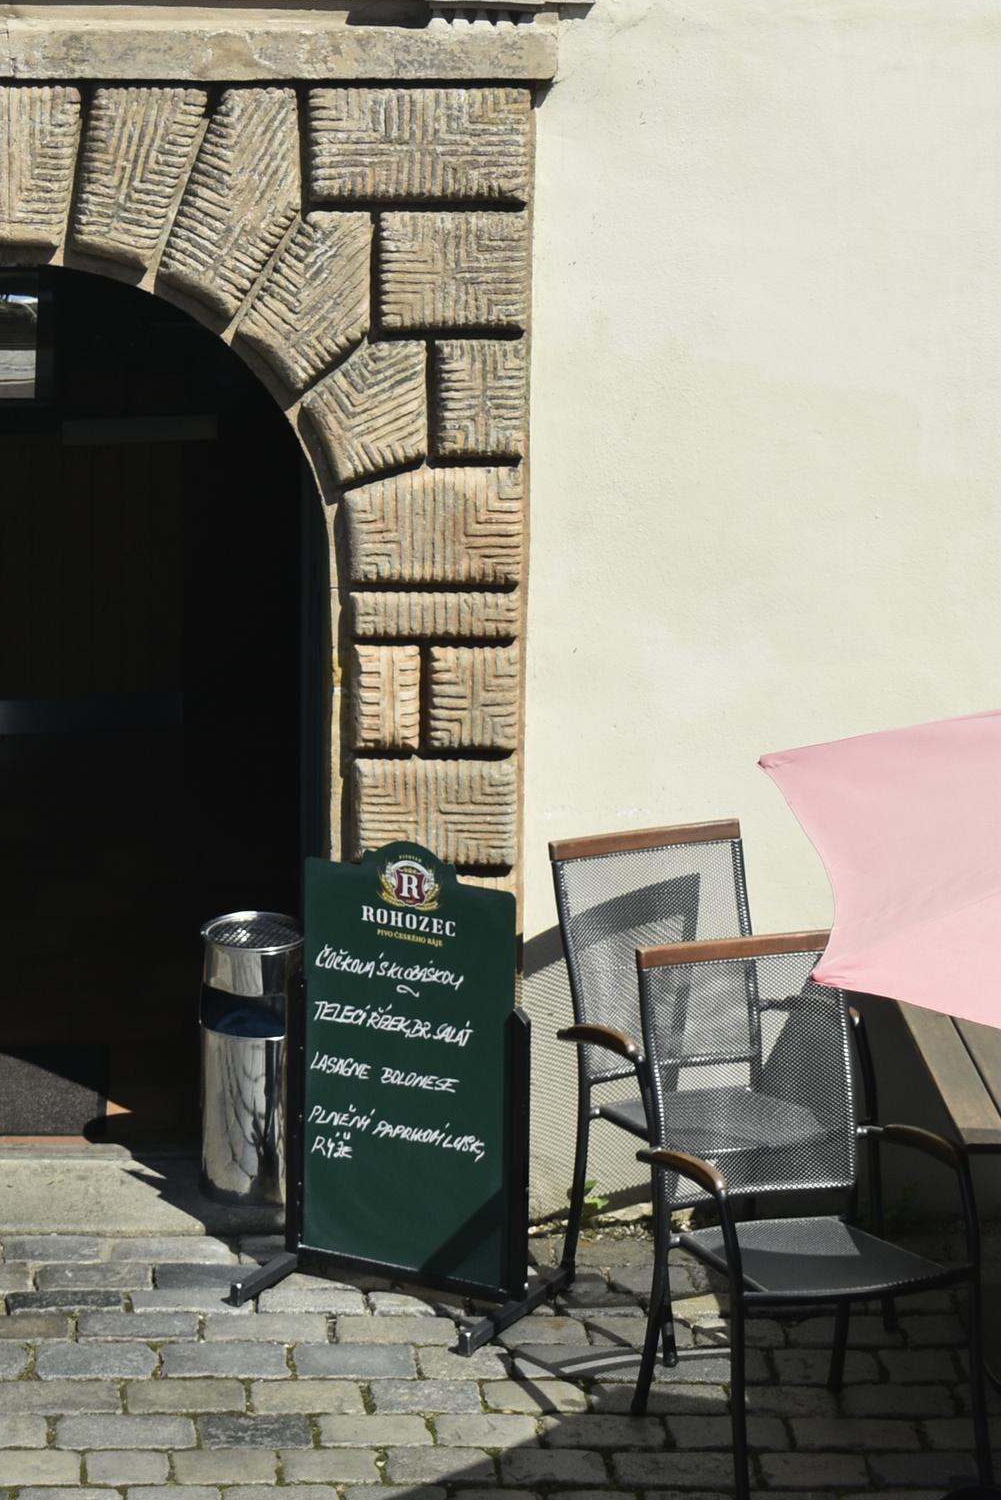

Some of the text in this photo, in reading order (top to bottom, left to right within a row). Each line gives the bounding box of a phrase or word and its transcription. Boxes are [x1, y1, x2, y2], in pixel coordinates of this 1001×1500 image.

[400, 873, 420, 900] R
[361, 905, 456, 937] ROHOZEC
[376, 928, 393, 938] PIVO
[315, 944, 384, 978] ČOČKOVÁ
[376, 961, 389, 976] S
[313, 1001, 371, 1026] TELECÍ
[432, 1020, 474, 1047] SALÁT
[310, 1051, 460, 1093] LASAGNE BOLONESE
[308, 1104, 375, 1131] PLNĚNÝ
[311, 1132, 352, 1159] RÝŽE
